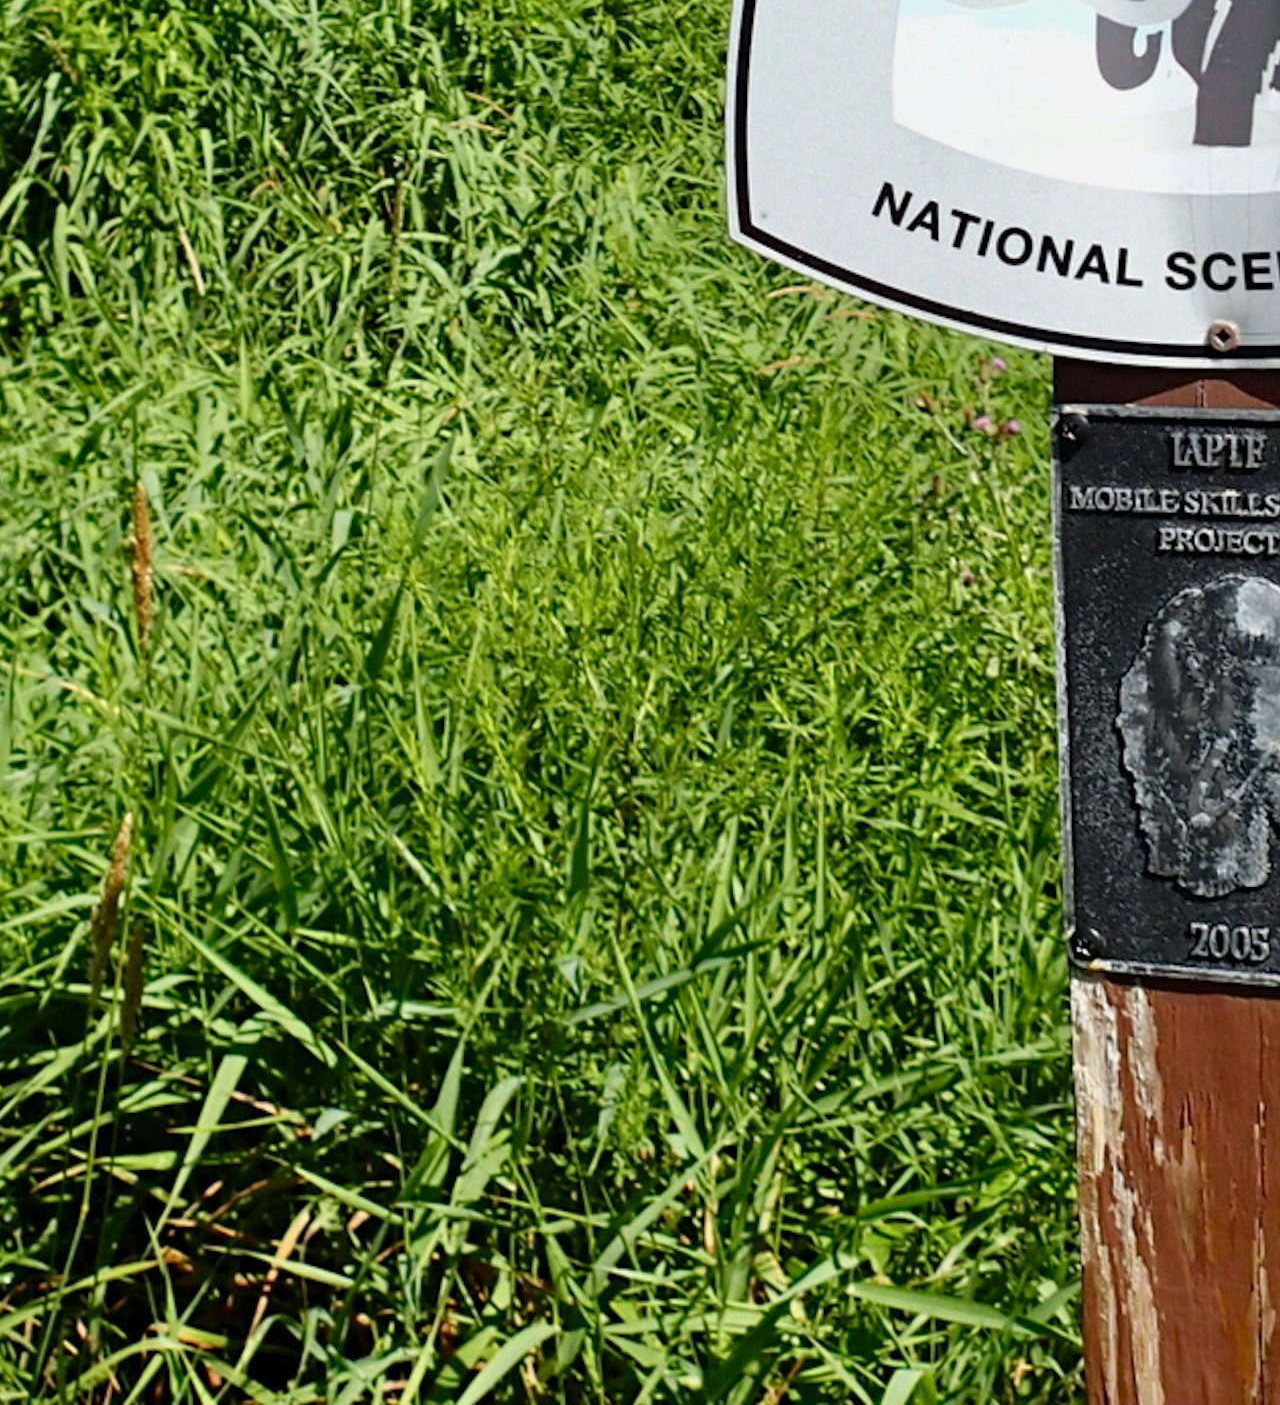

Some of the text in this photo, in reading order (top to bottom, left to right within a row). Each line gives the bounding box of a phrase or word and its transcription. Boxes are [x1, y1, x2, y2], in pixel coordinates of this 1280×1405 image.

[871, 181, 1144, 288] NATIONAL
[1069, 486, 1180, 514] MOBILE
[1159, 527, 1280, 555] PROJECT
[1189, 922, 1271, 961] 2005
